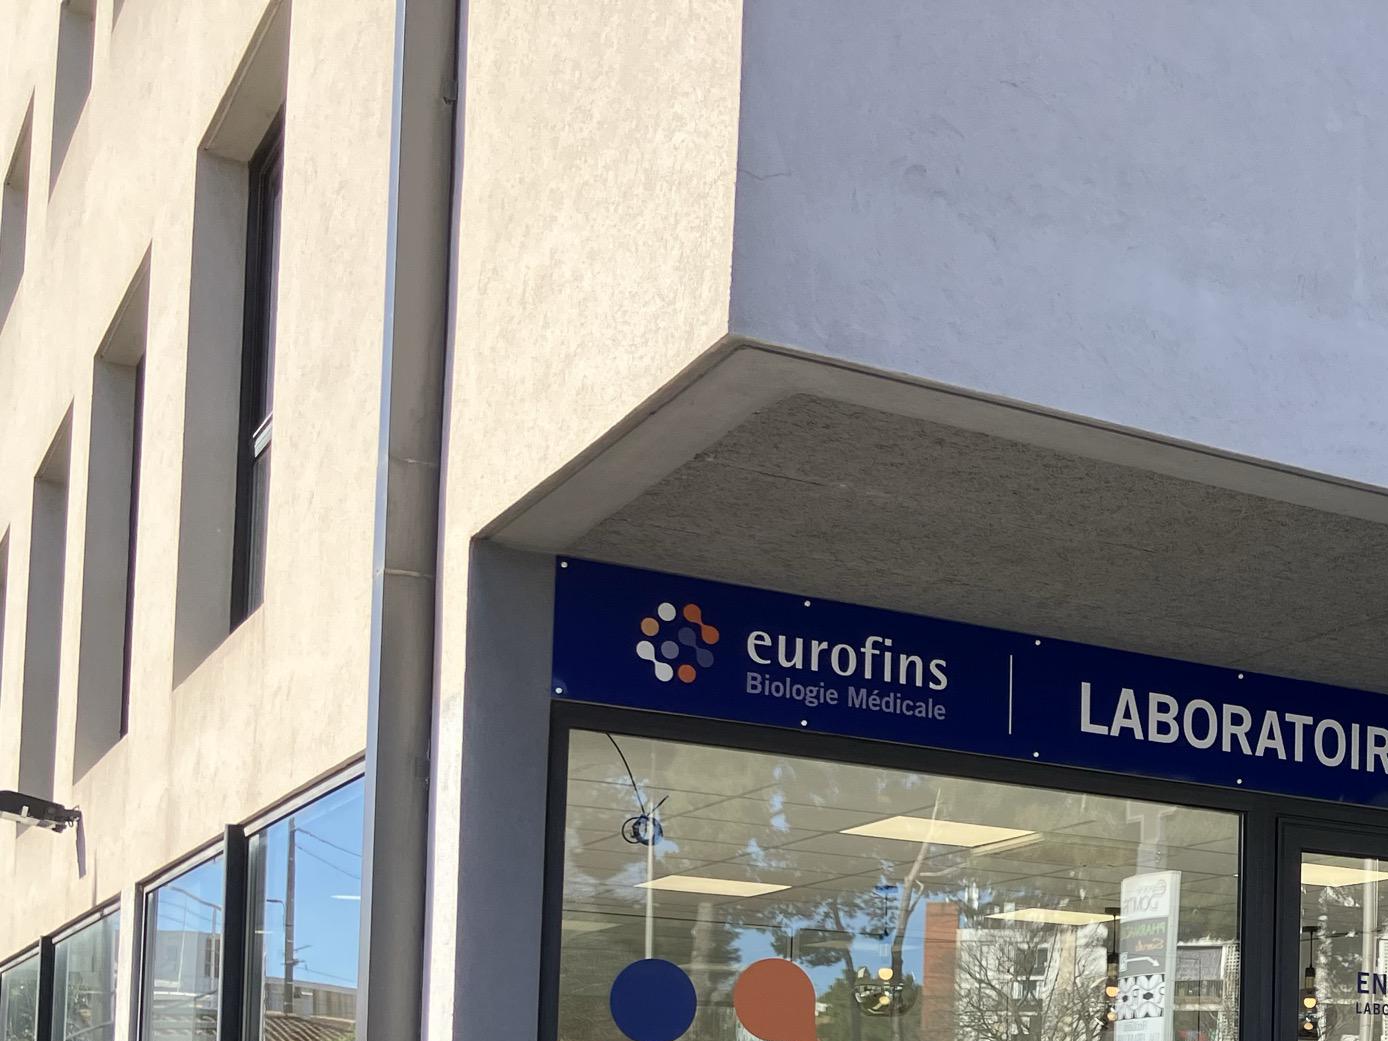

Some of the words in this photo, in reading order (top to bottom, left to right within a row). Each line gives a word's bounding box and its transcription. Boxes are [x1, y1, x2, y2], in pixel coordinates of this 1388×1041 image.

[746, 629, 949, 691] eurofins
[745, 672, 839, 707] Biologie
[847, 686, 947, 721] Médicale
